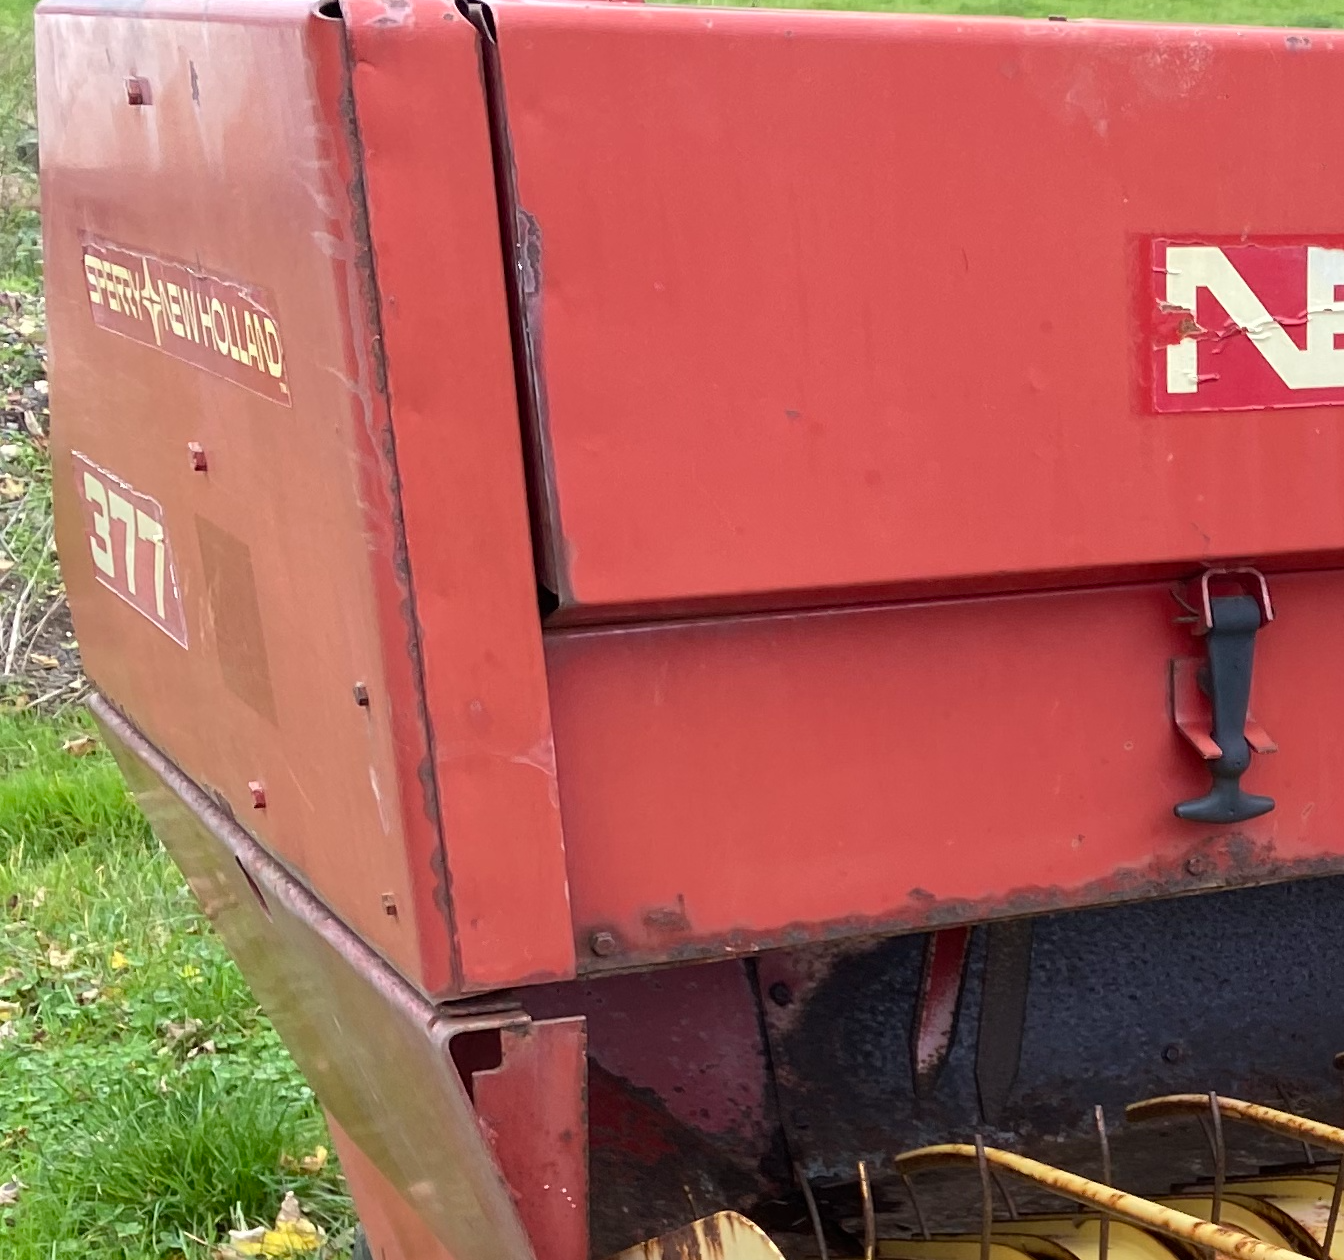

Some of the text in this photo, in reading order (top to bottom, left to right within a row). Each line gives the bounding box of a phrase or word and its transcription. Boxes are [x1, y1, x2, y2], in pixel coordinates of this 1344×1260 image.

[84, 253, 284, 379] SPERRY NEW HOLLAND
[83, 471, 166, 621] 377
